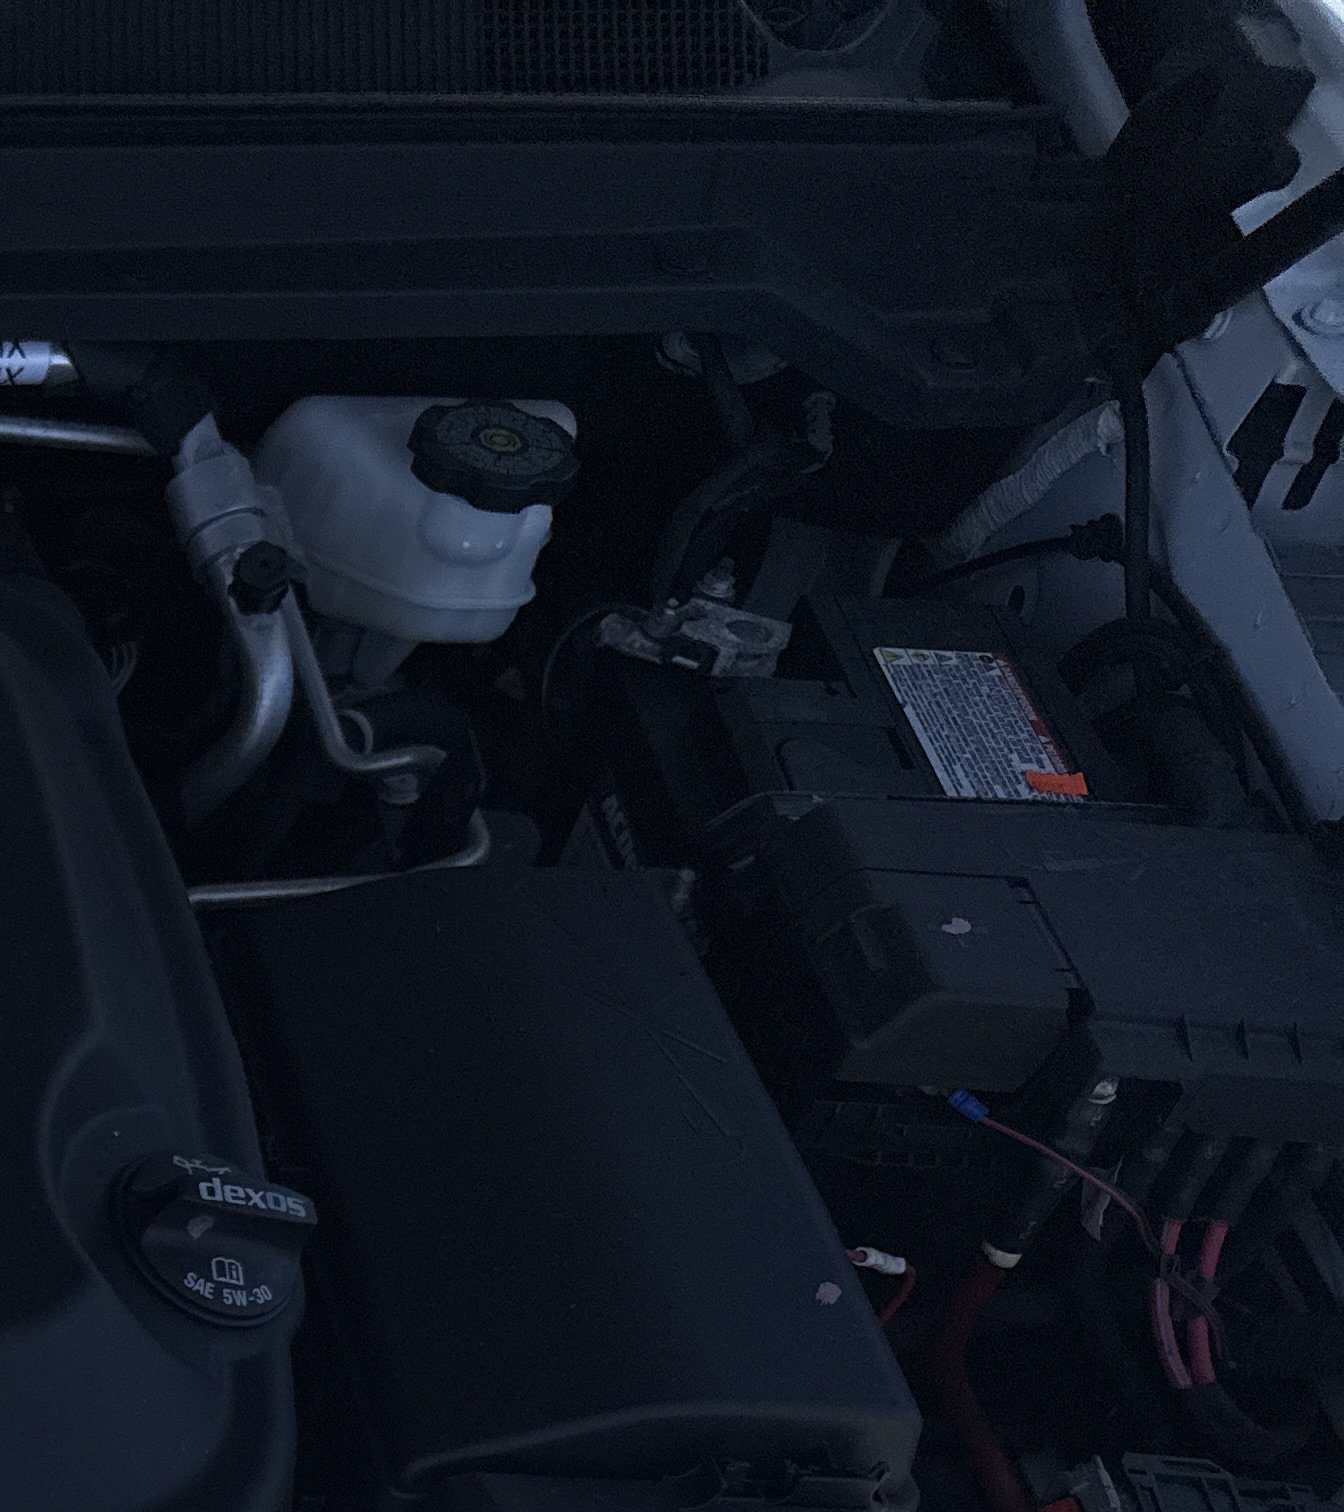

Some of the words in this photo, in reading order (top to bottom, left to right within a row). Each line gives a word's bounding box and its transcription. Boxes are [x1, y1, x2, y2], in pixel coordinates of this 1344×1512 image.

[198, 1177, 307, 1218] dexos
[183, 1271, 215, 1300] SAE
[222, 1284, 273, 1308] 5W-30
